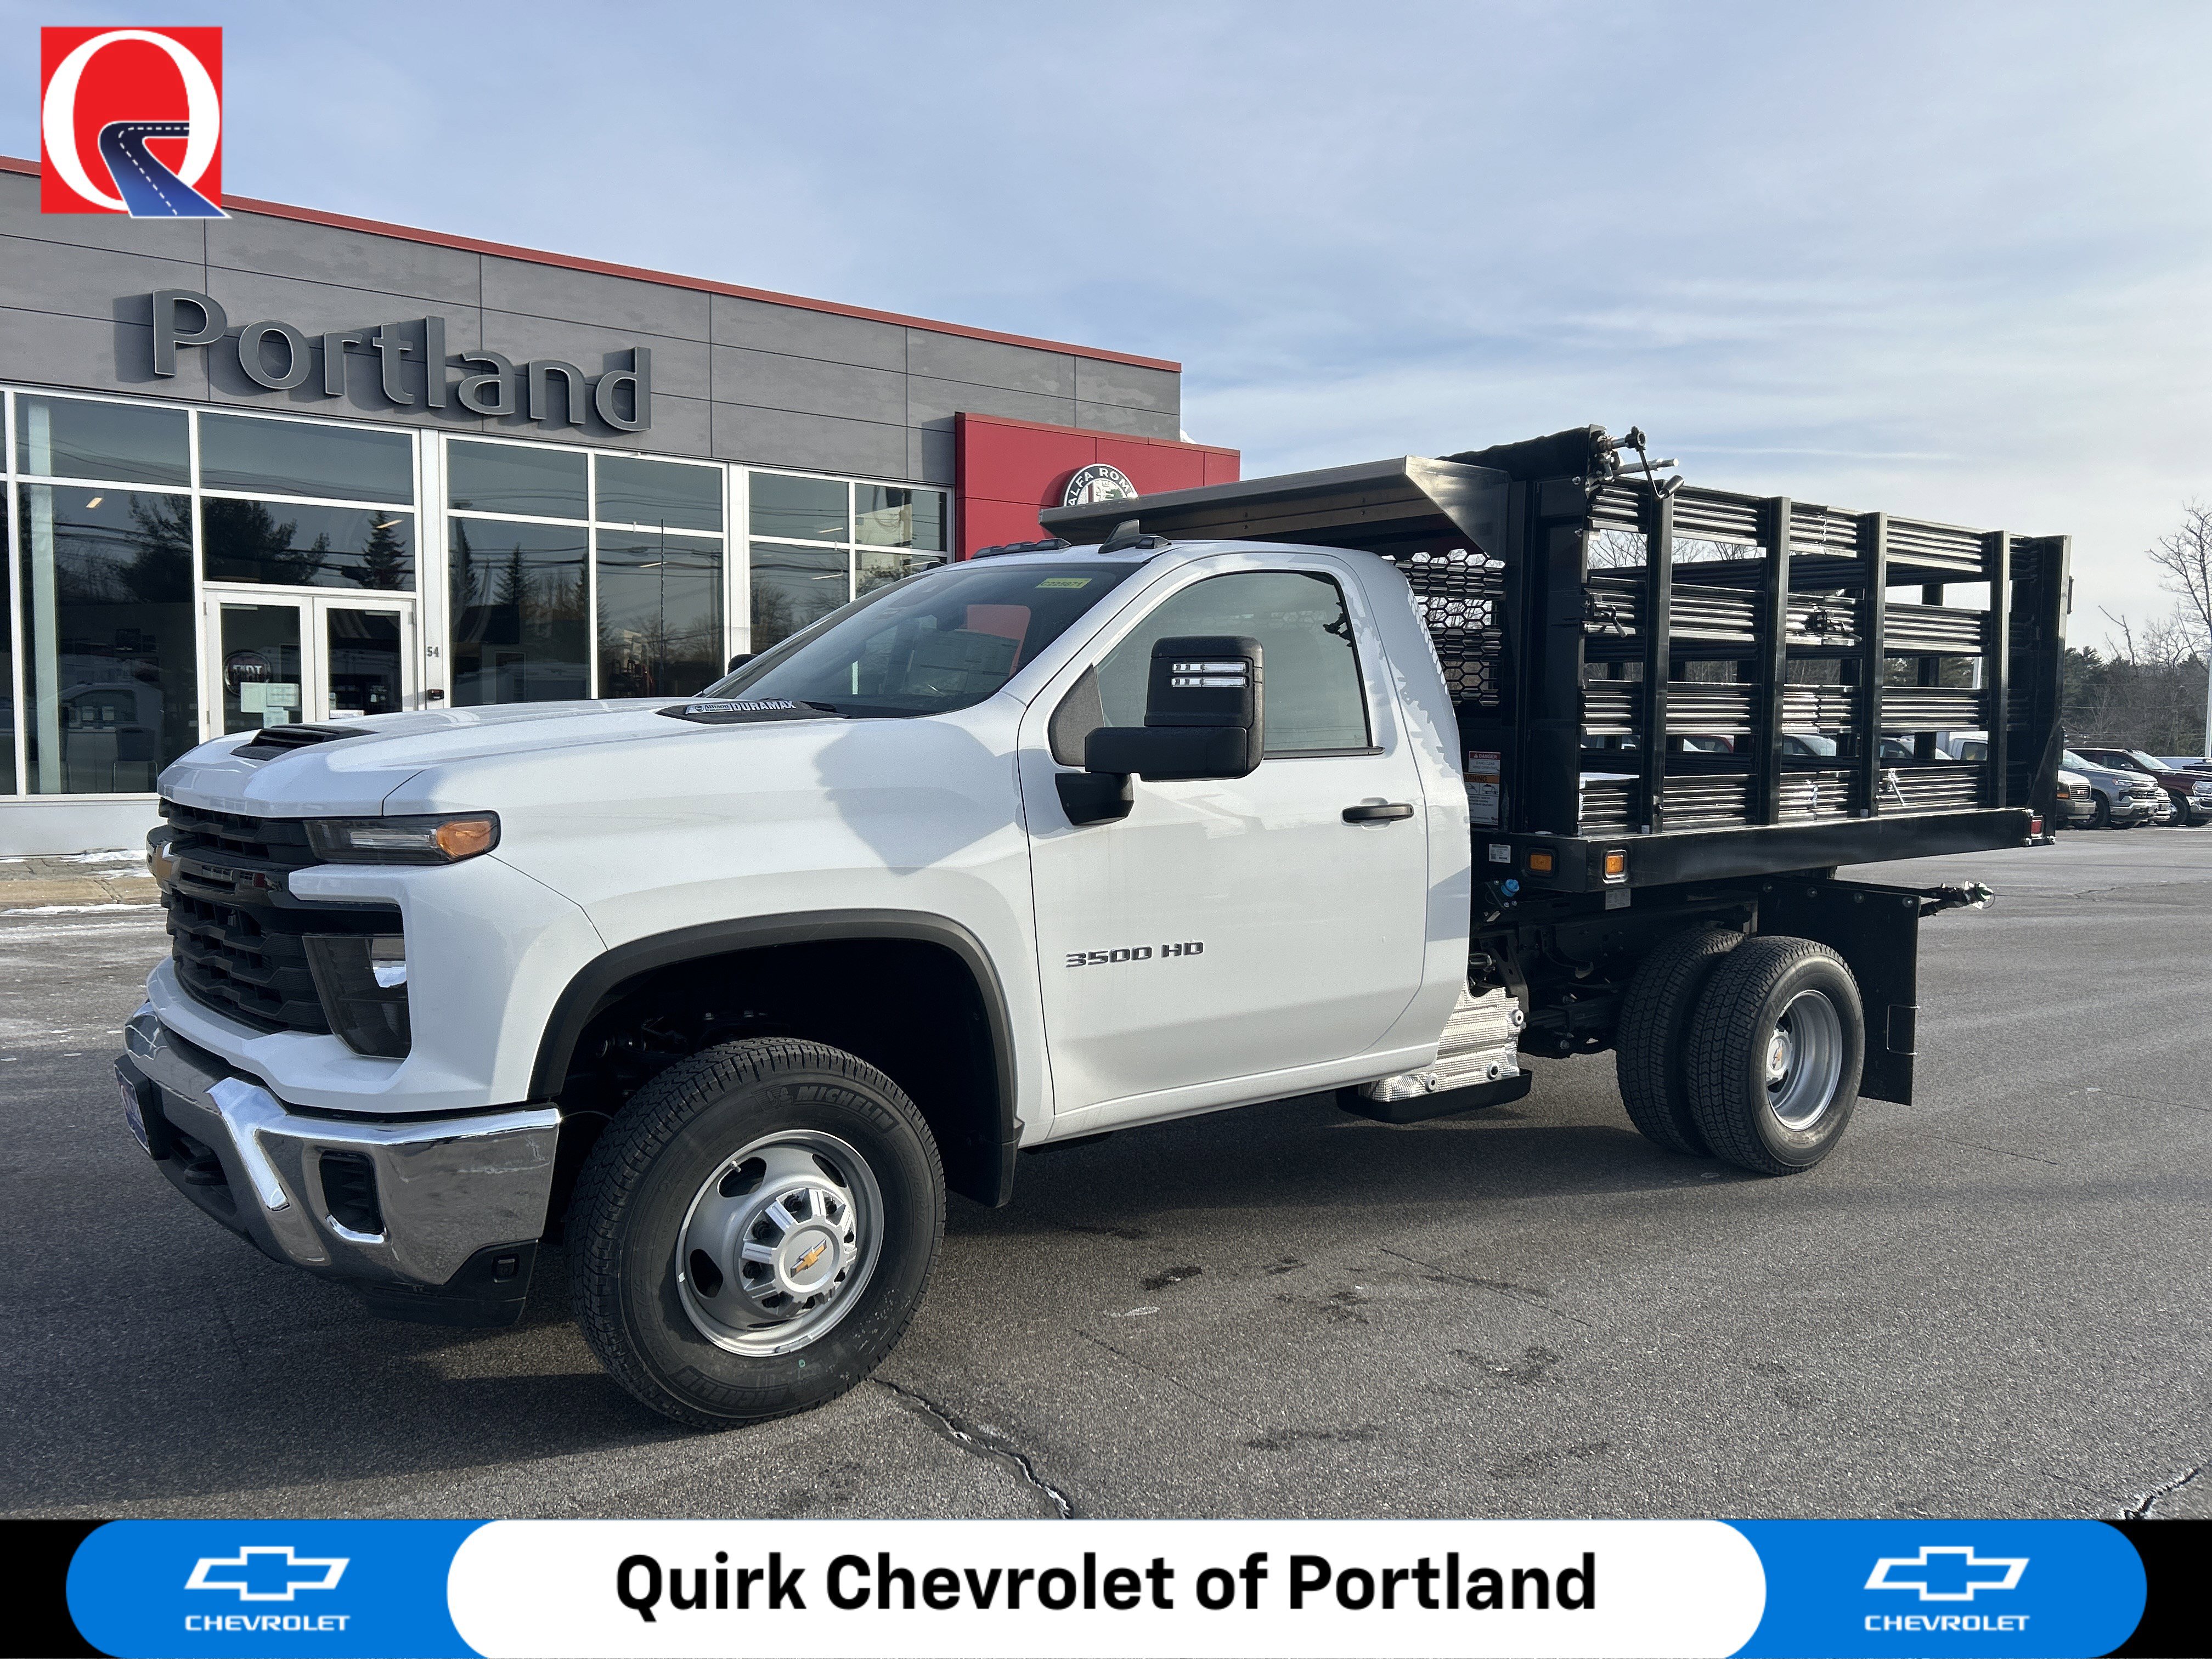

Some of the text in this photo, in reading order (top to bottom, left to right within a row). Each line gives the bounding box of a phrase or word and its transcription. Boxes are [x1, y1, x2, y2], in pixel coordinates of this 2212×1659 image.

[152, 289, 652, 432] Portland
[1068, 467, 1135, 506] ALFA ROM
[426, 646, 439, 658] 54
[732, 701, 797, 712] DURAMAX
[1464, 774, 1487, 782] ARNING
[1065, 941, 1204, 968] 3500 HD
[796, 1086, 895, 1127] MICHELIN
